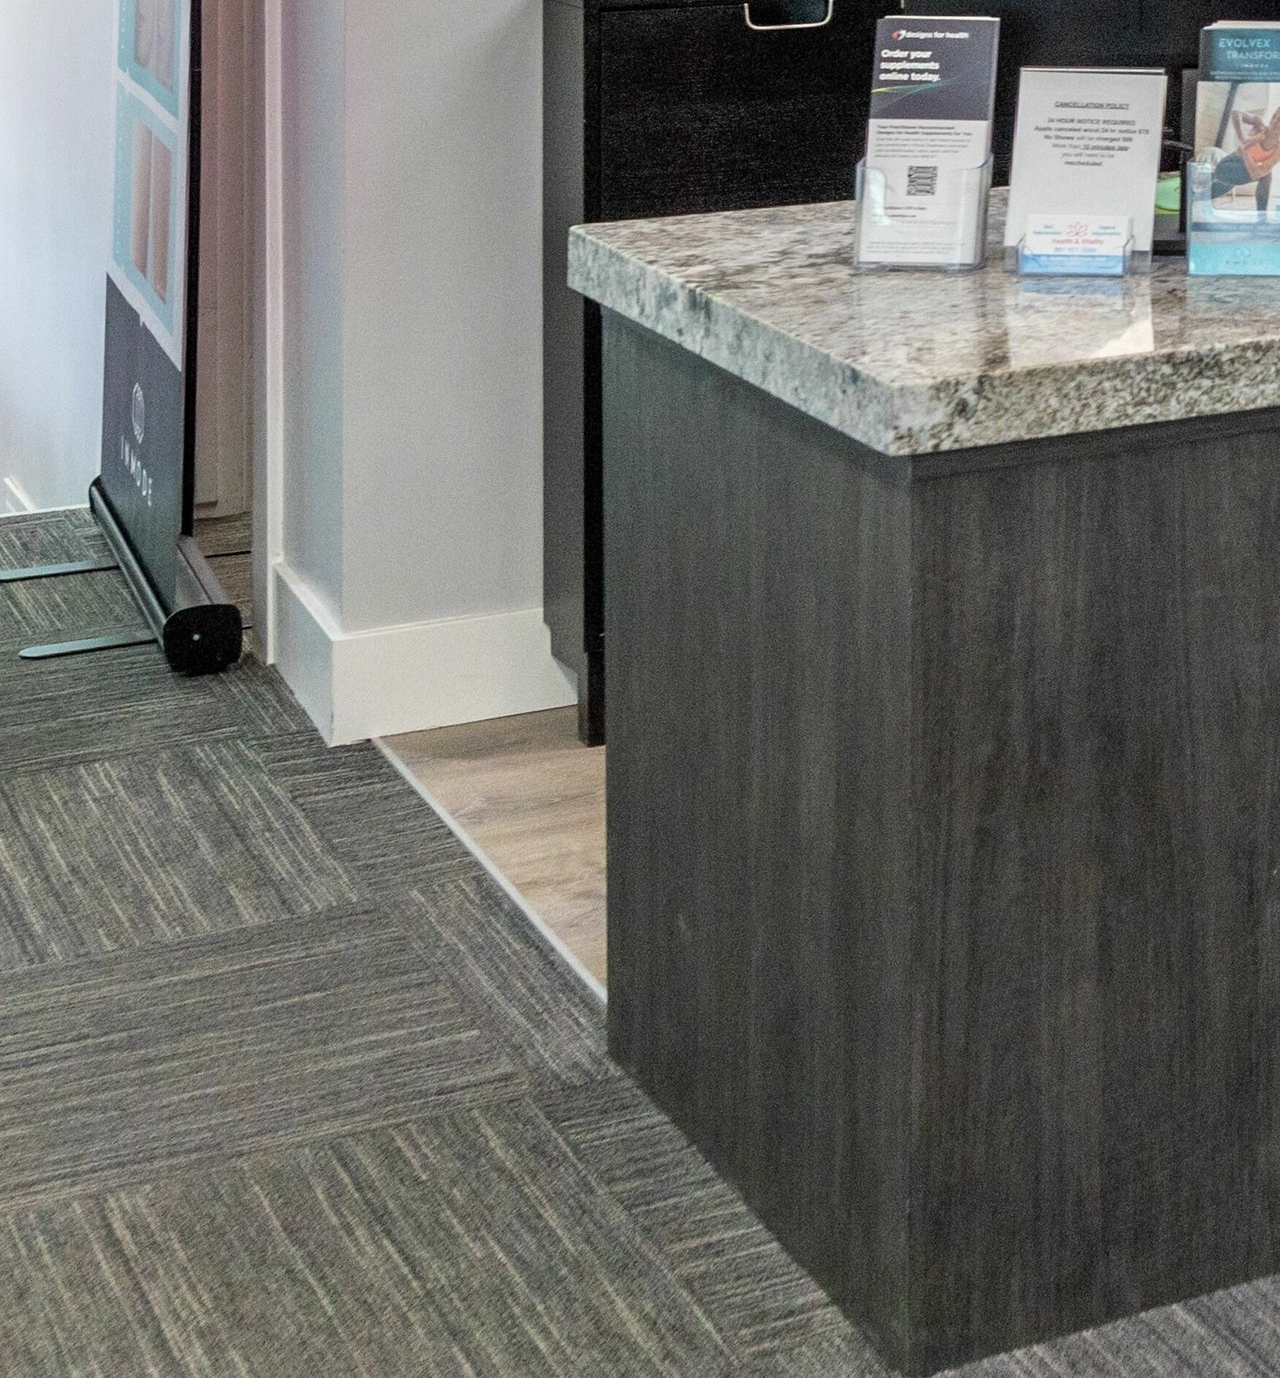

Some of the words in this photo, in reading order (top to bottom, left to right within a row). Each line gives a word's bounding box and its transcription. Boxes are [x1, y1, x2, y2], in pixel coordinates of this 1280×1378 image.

[1219, 38, 1271, 48] EVOLVEX
[881, 49, 909, 58] Order
[910, 51, 932, 59] your
[880, 61, 940, 70] supplements
[879, 72, 909, 80] online
[910, 72, 941, 82] today.
